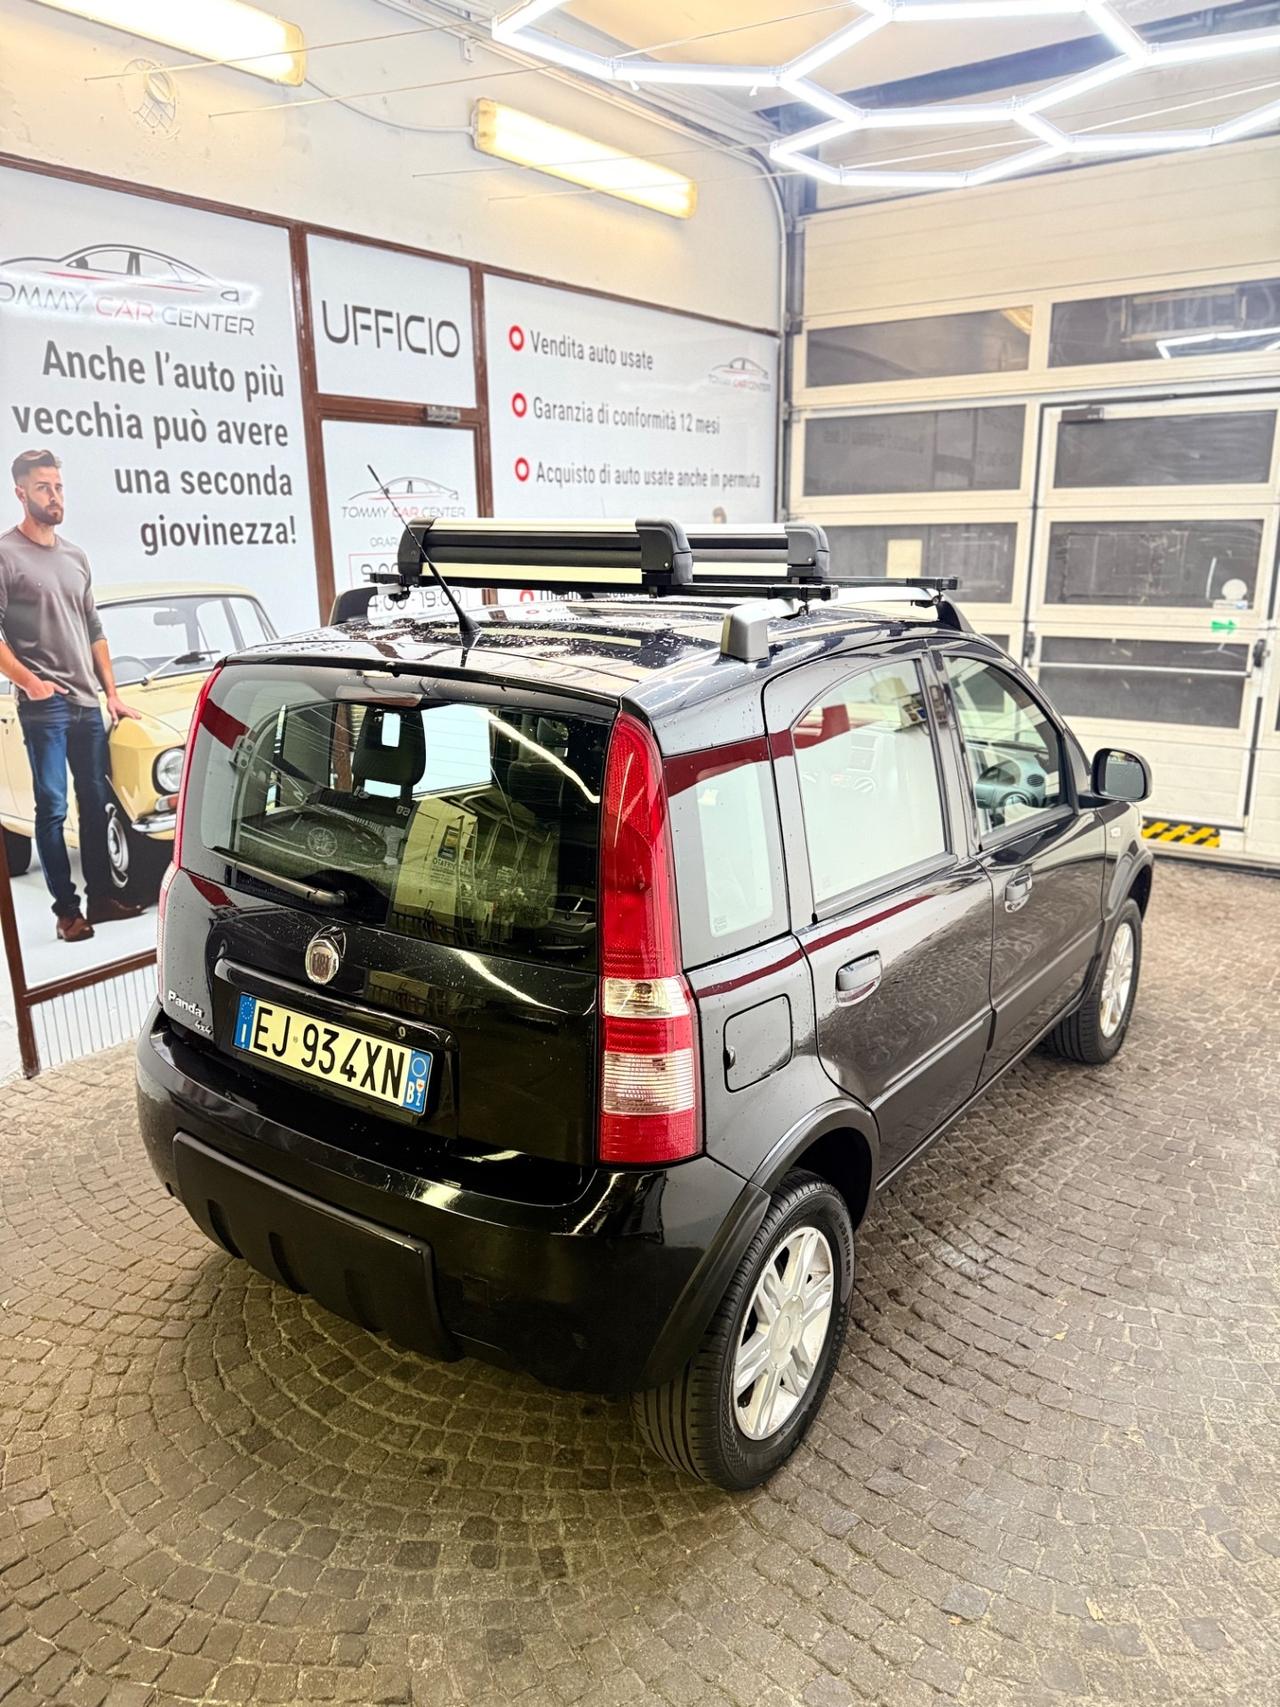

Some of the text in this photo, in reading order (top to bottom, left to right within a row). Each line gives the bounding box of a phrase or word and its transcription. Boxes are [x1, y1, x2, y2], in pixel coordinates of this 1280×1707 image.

[0, 282, 255, 336] OMMY CAR CENTER
[322, 300, 461, 358] UFFICIO
[530, 330, 654, 370] Vendita auto usate
[42, 339, 146, 385] Anche
[245, 364, 285, 403] più
[11, 401, 289, 450] vecchia può avere
[533, 396, 721, 435] Garanzia di conformità 12 mesi
[114, 464, 293, 496] una seconda
[536, 461, 761, 491] Acquisto di auto usate anche in permuta
[341, 506, 466, 519] TOMMY CAR CENTER
[140, 515, 297, 556] giovinezza!
[369, 536, 399, 548] ORAR
[420, 588, 462, 608] 19:00
[168, 989, 203, 1018] Panda
[252, 1005, 292, 1058] EJ
[300, 1022, 406, 1100] 934XN
